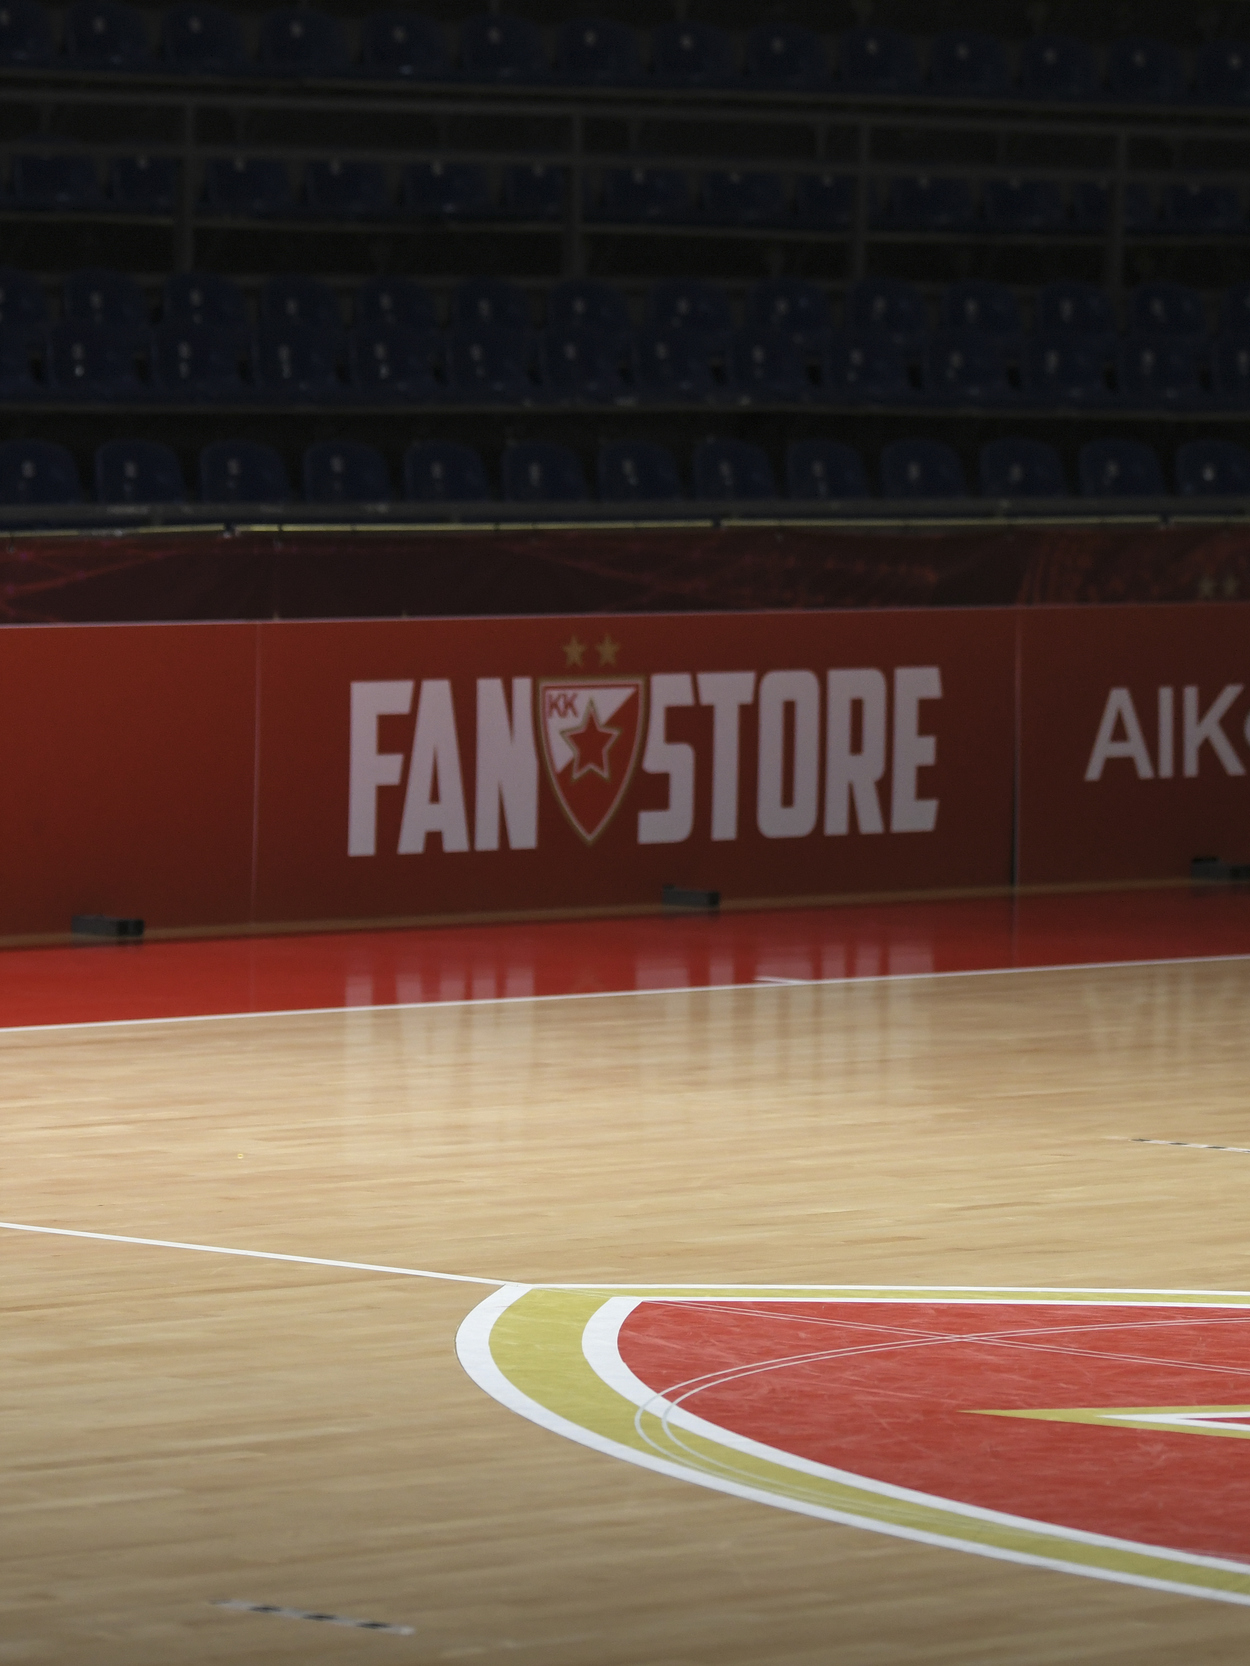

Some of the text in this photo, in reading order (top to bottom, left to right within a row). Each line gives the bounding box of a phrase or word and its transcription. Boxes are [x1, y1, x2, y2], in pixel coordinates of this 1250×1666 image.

[547, 692, 579, 719] KK
[1084, 684, 1246, 782] AIK
[348, 665, 942, 857] FAN STORE
